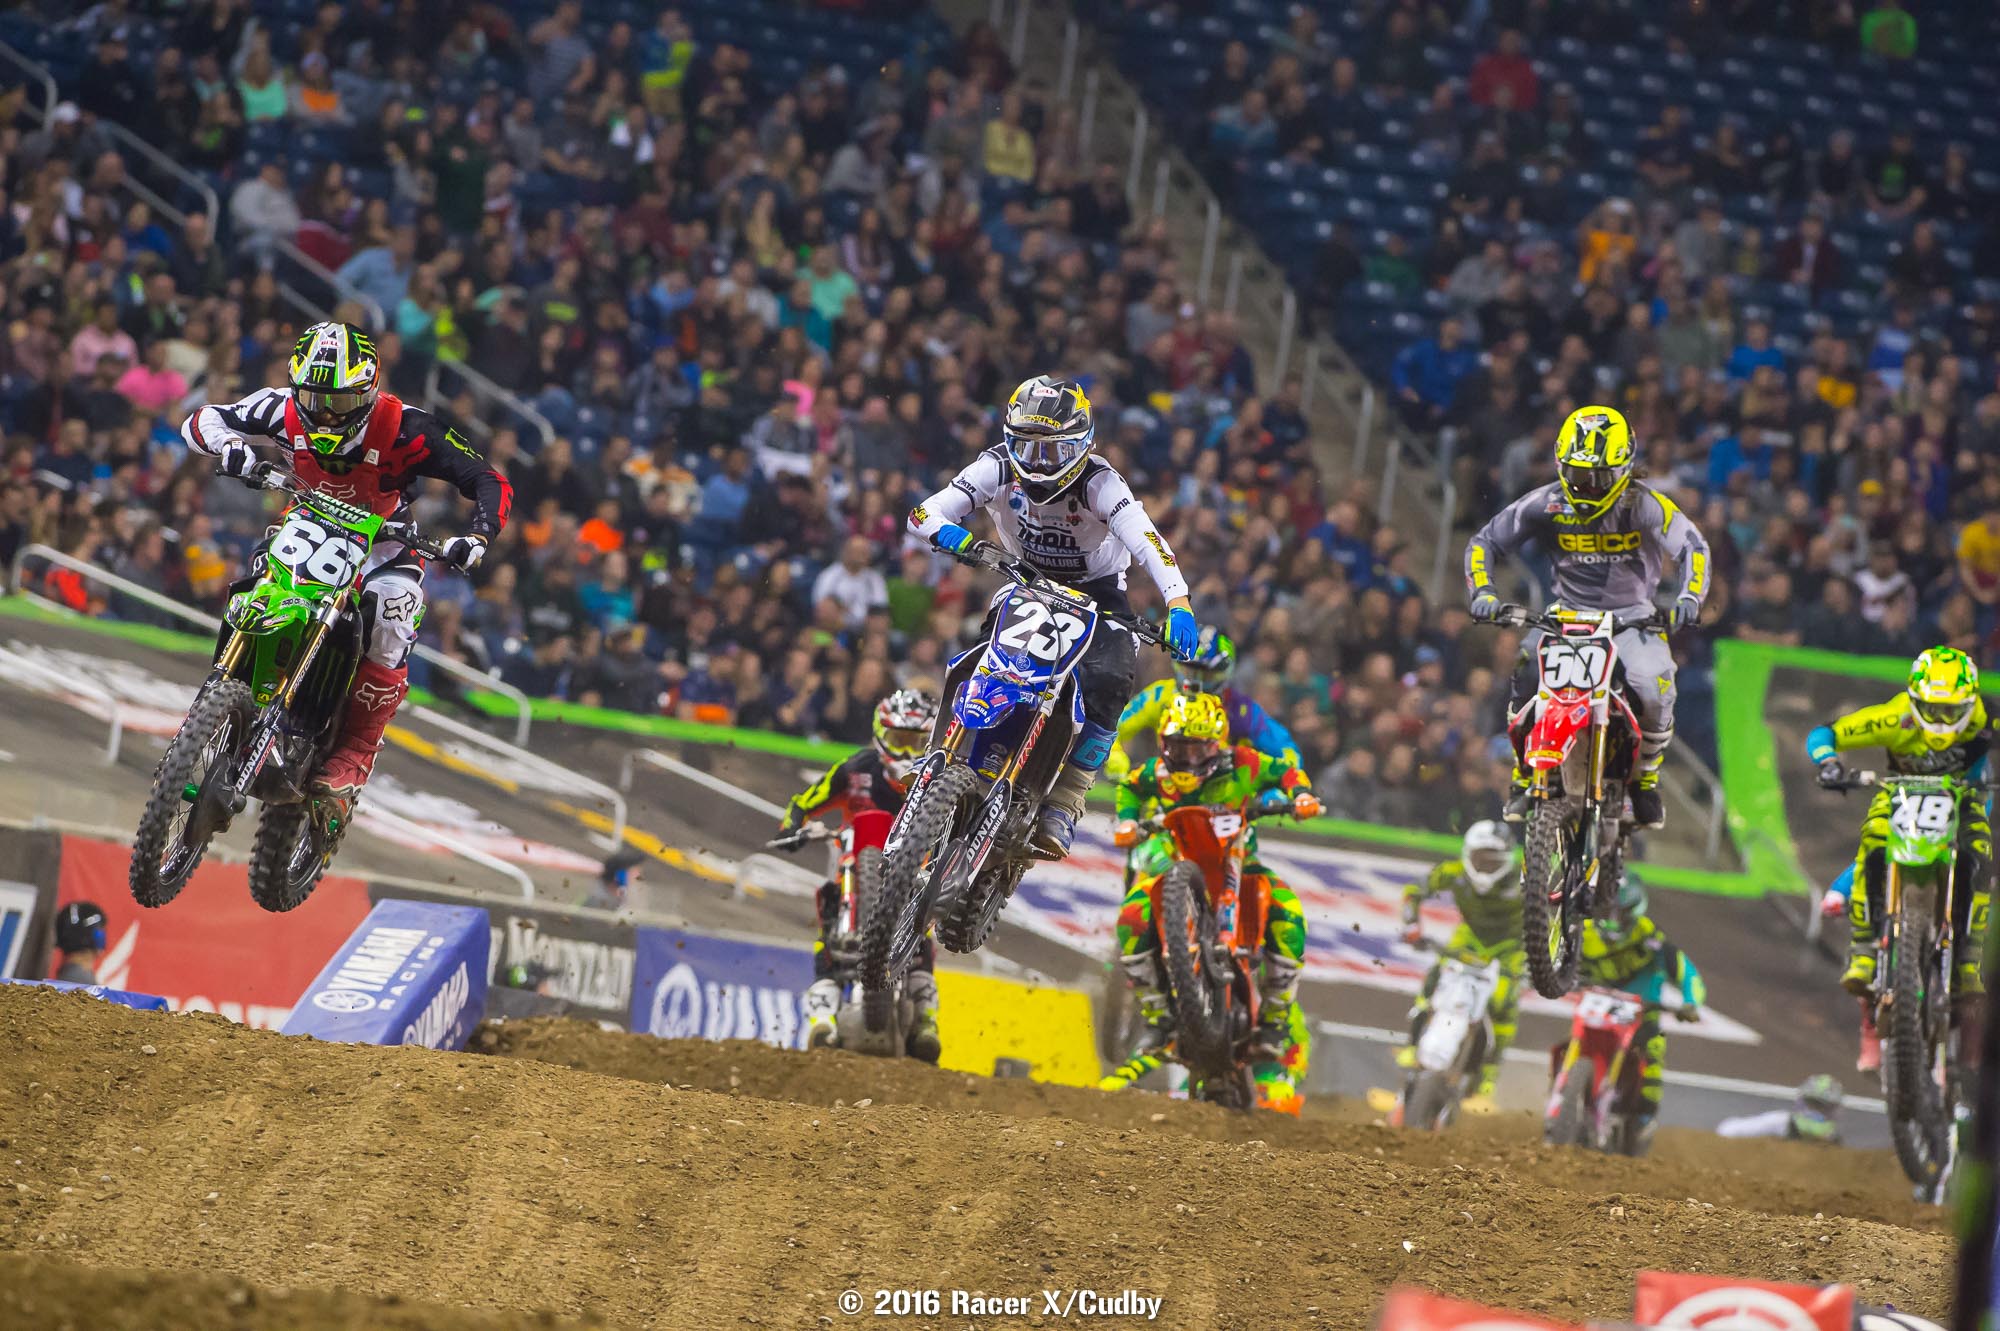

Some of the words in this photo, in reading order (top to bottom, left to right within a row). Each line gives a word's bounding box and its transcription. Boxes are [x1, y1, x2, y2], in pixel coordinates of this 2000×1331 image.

[271, 519, 366, 587] 66
[1023, 551, 1081, 568] YAMALUBE
[1558, 530, 1642, 553] GEICO
[1570, 552, 1633, 565] HONDA
[998, 601, 1086, 661] 23
[1544, 645, 1607, 689] 50
[966, 703, 988, 717] YAMAHA
[235, 727, 271, 792] DUNLOP
[966, 793, 1004, 864] DUNLOP
[1891, 795, 1954, 829] 48
[326, 927, 428, 992] YAMAHA
[377, 936, 445, 1011] RACING
